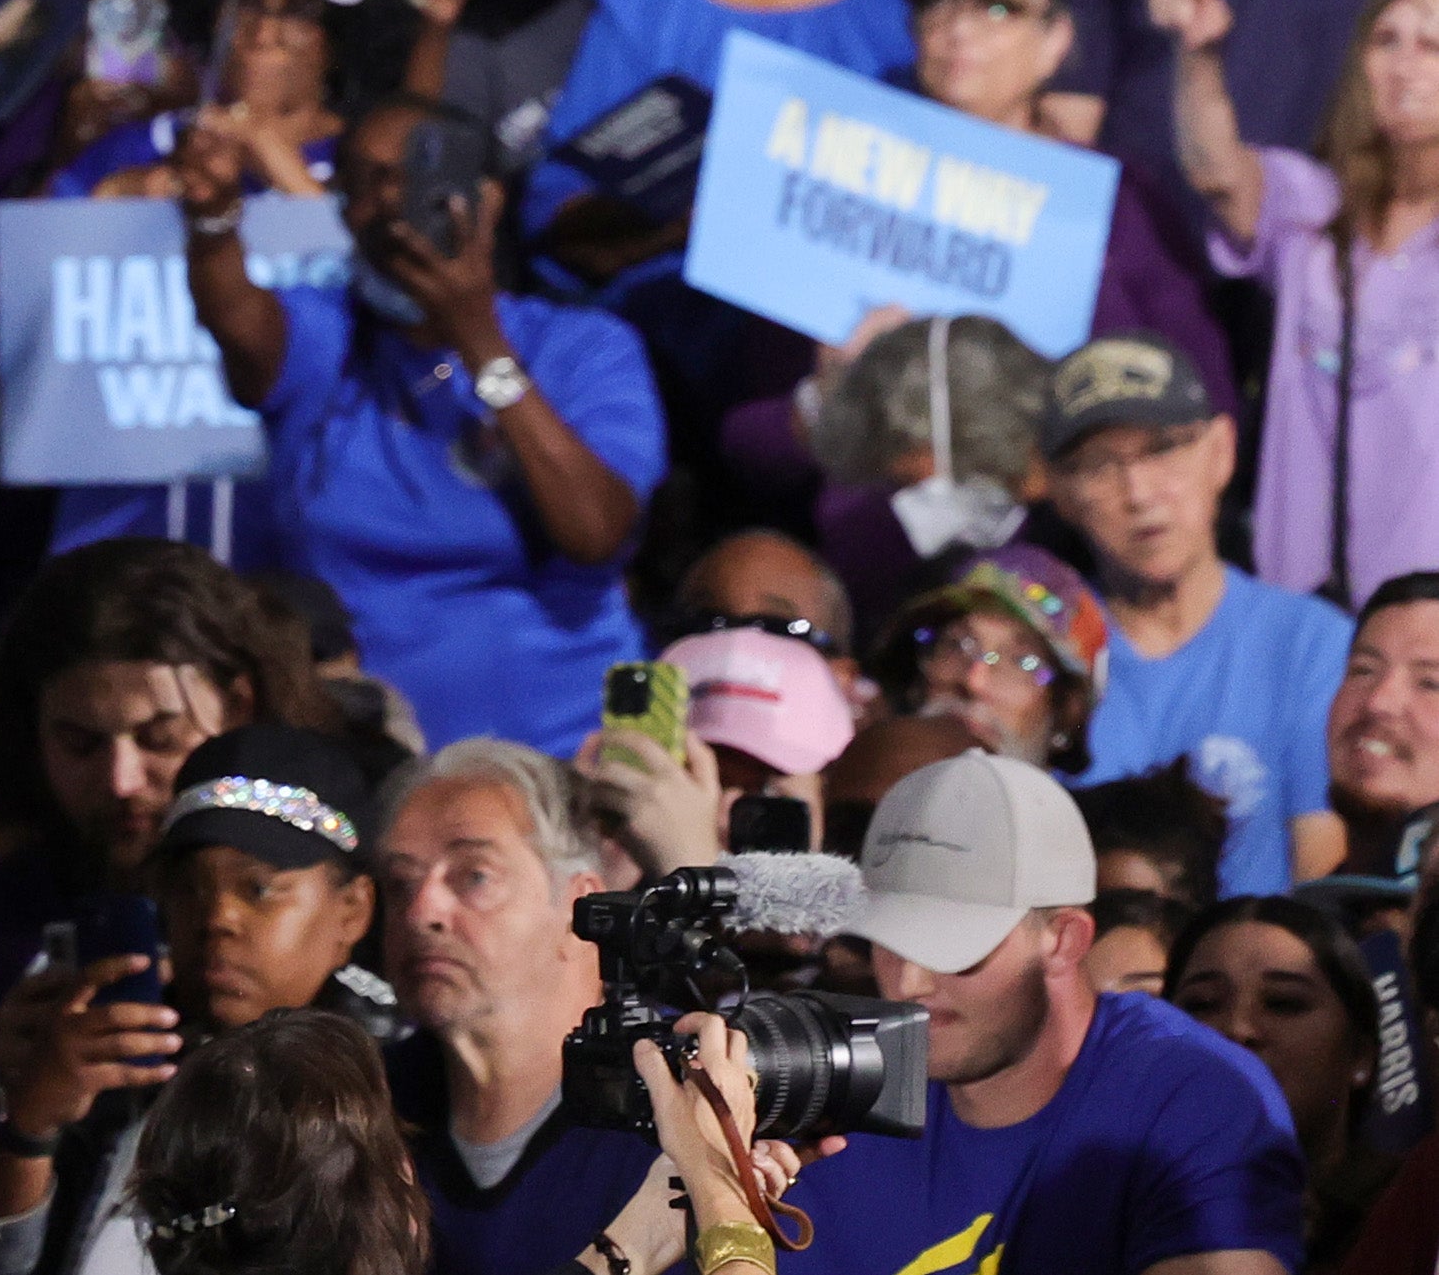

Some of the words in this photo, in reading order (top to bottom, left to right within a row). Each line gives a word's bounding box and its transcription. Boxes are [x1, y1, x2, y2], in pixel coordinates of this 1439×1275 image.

[768, 97, 806, 170] A
[810, 114, 932, 211] NEW
[934, 153, 1049, 247] WAY
[776, 169, 1016, 301] FORWARD
[1373, 971, 1420, 1115] HARRIS
